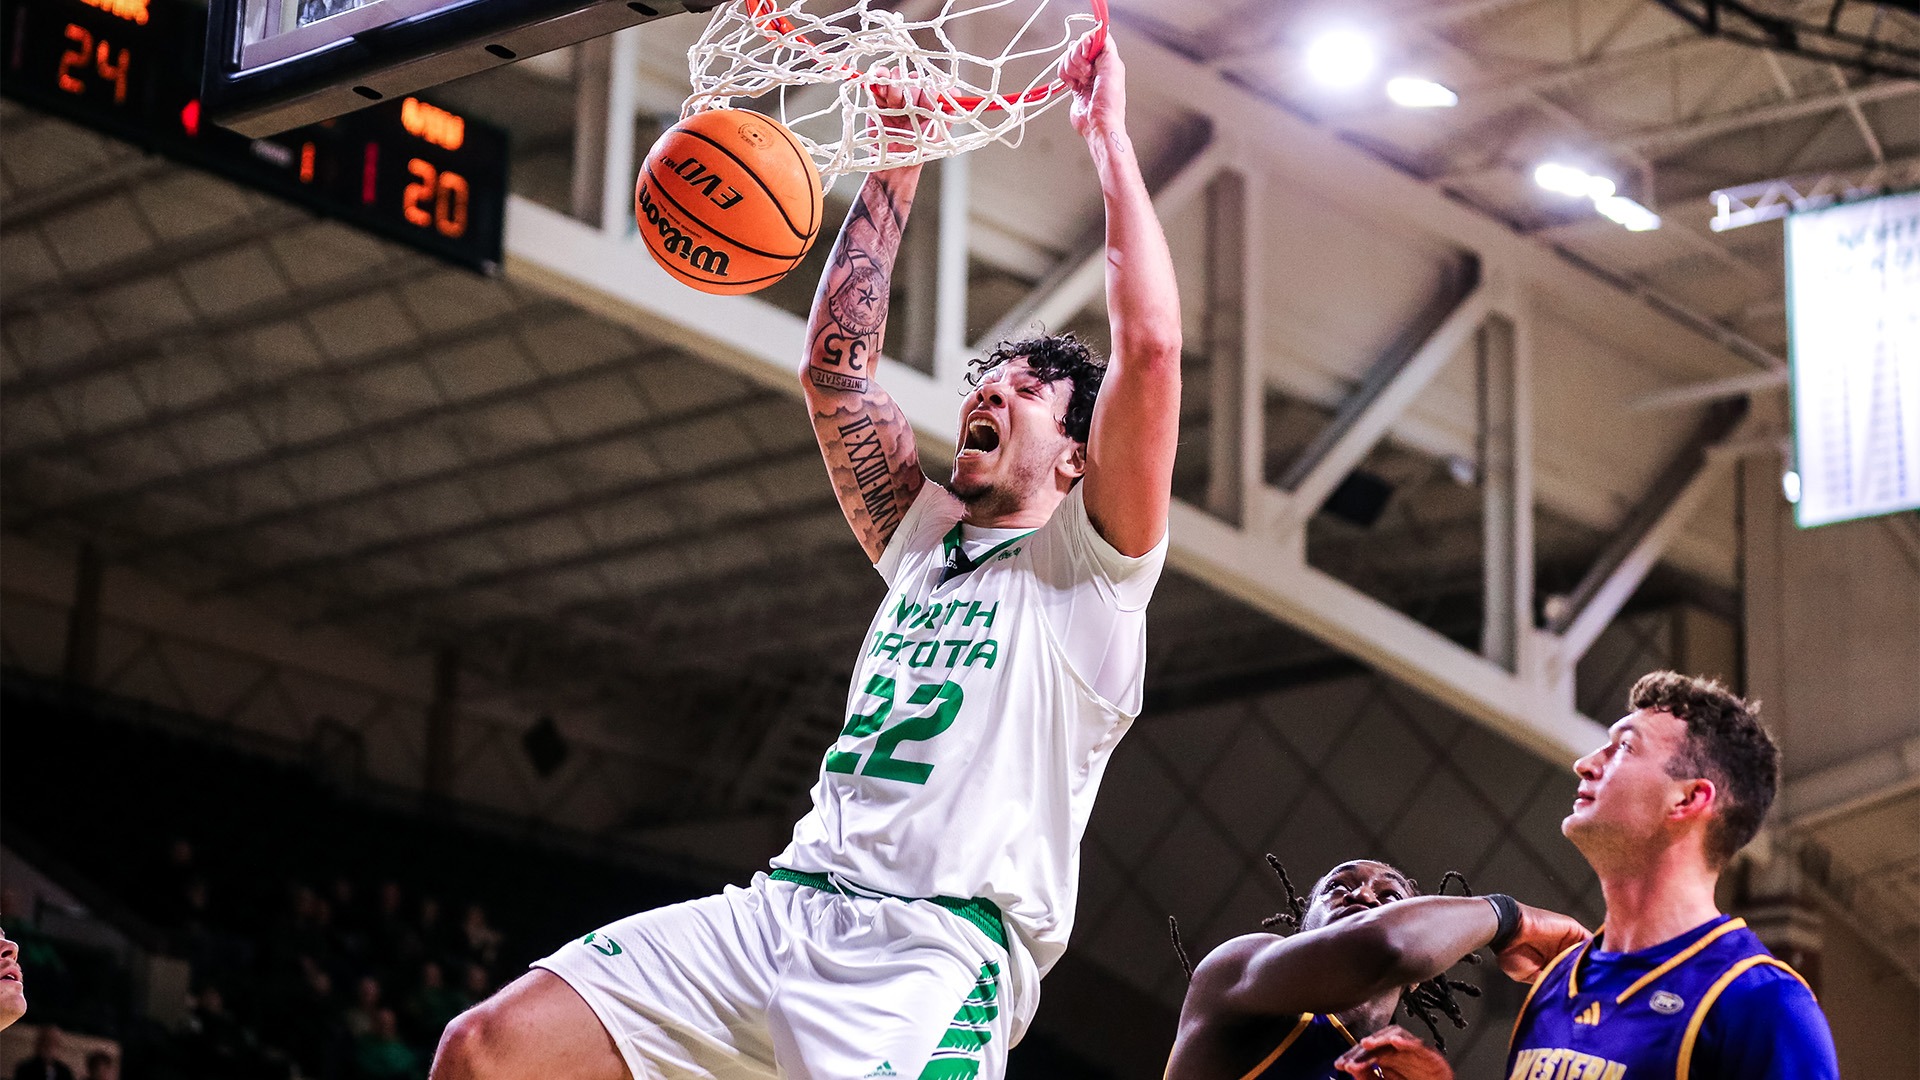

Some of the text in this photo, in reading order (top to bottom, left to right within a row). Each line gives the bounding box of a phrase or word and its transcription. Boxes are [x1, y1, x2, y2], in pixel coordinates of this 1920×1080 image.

[58, 23, 130, 103] 24
[403, 157, 470, 239] 20
[639, 181, 730, 277] Wilson
[815, 370, 863, 389] INTERSTATE
[822, 333, 867, 371] 35
[825, 673, 964, 785] 22
